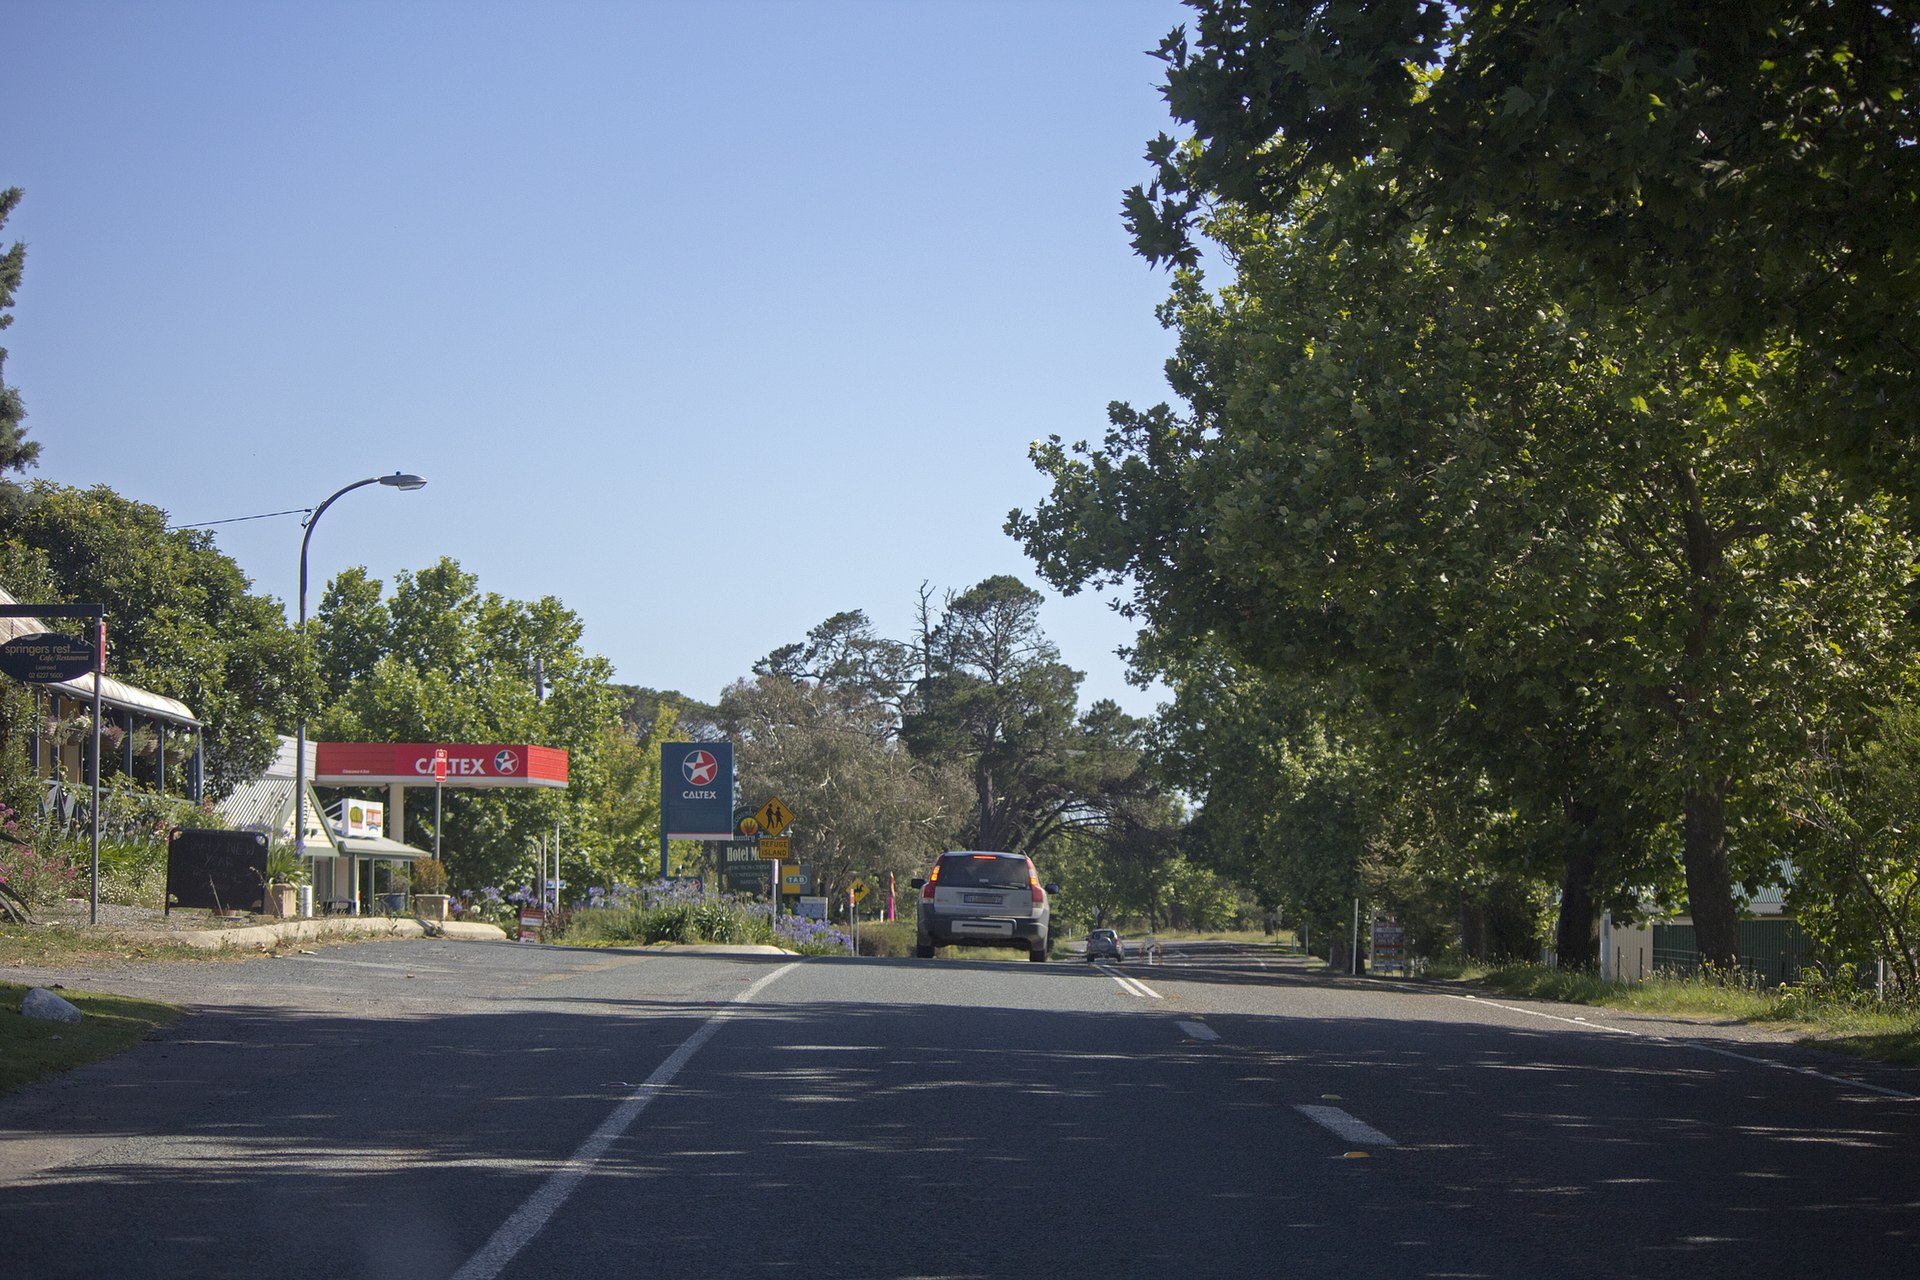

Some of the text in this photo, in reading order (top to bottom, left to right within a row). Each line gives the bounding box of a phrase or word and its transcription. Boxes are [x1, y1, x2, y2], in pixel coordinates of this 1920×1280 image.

[5, 644, 71, 656] springers rest
[682, 790, 717, 800] CALTEX
[726, 846, 749, 861] Hotel
[761, 849, 787, 857] ISLAND
